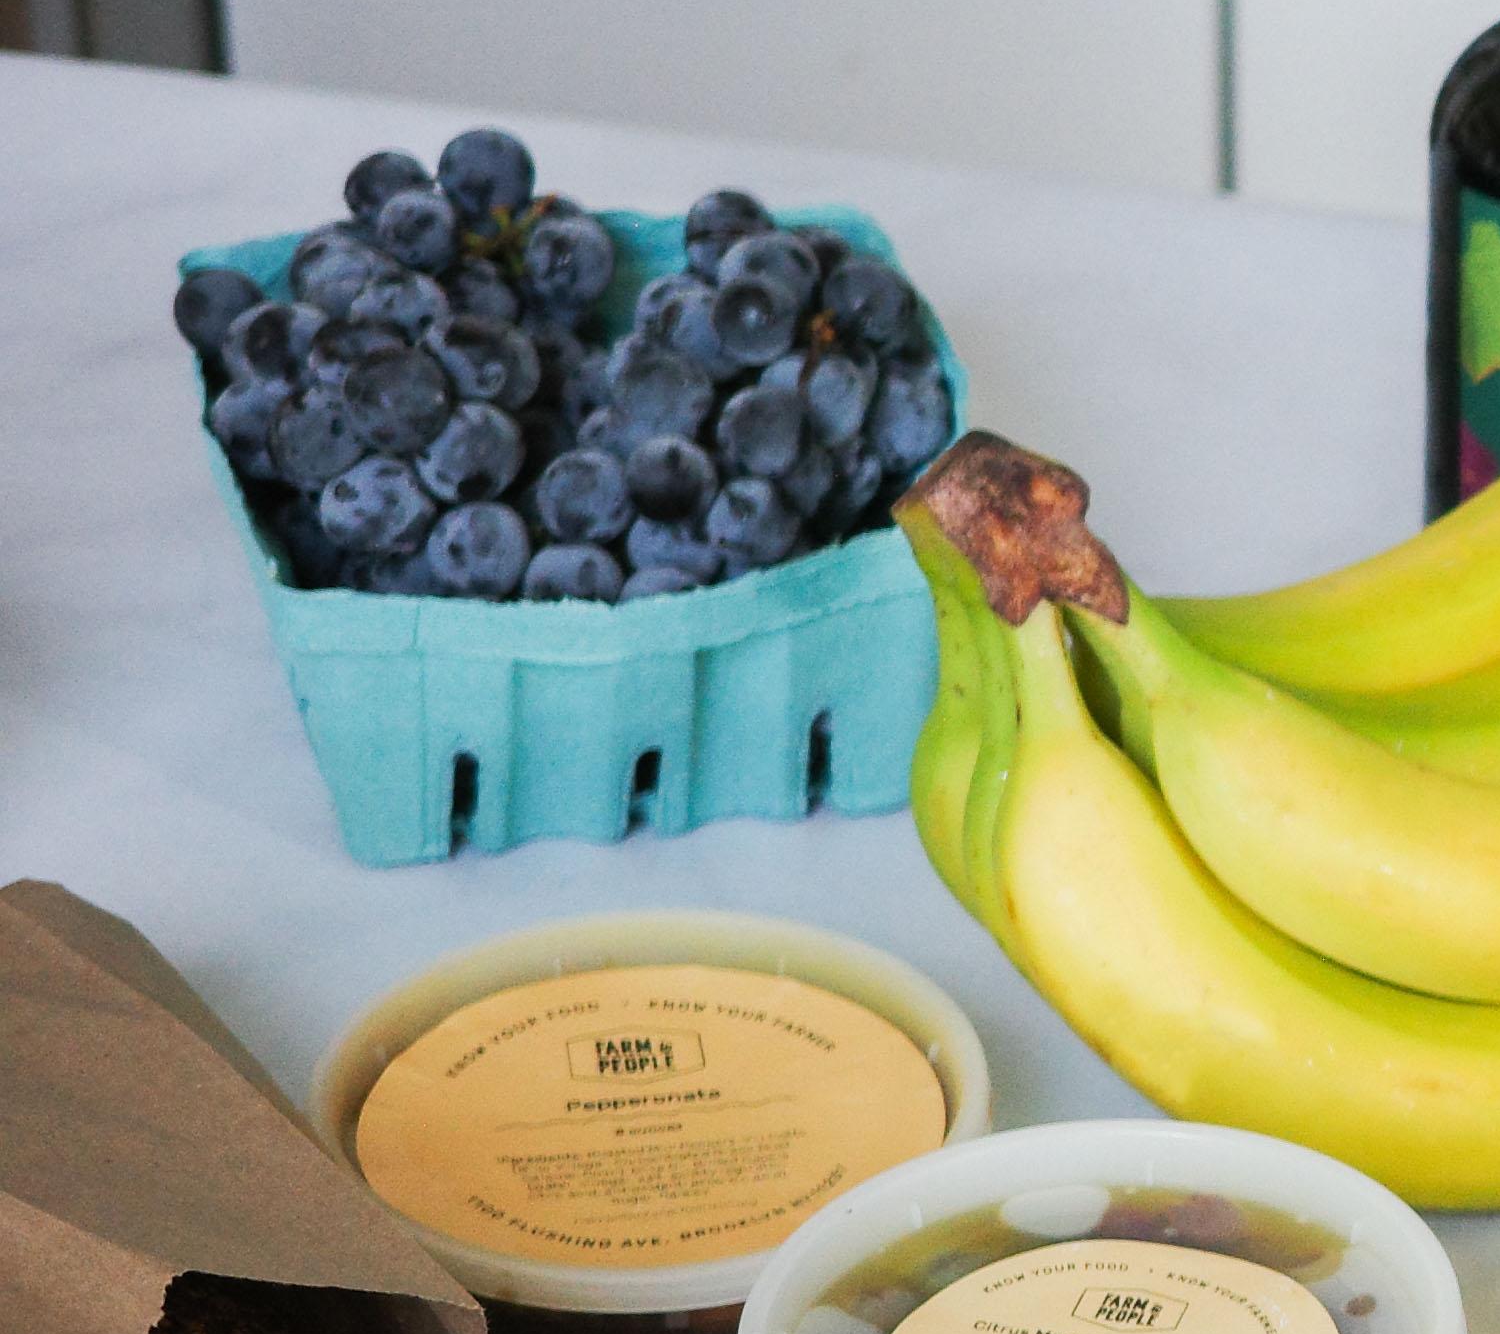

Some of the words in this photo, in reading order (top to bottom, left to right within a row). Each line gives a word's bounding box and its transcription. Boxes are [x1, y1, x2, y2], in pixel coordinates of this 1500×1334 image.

[595, 1037, 651, 1056] FARM
[598, 1054, 674, 1075] PEOPLE
[1102, 1292, 1150, 1313] FARM
[1095, 1307, 1159, 1327] PEOPLE
